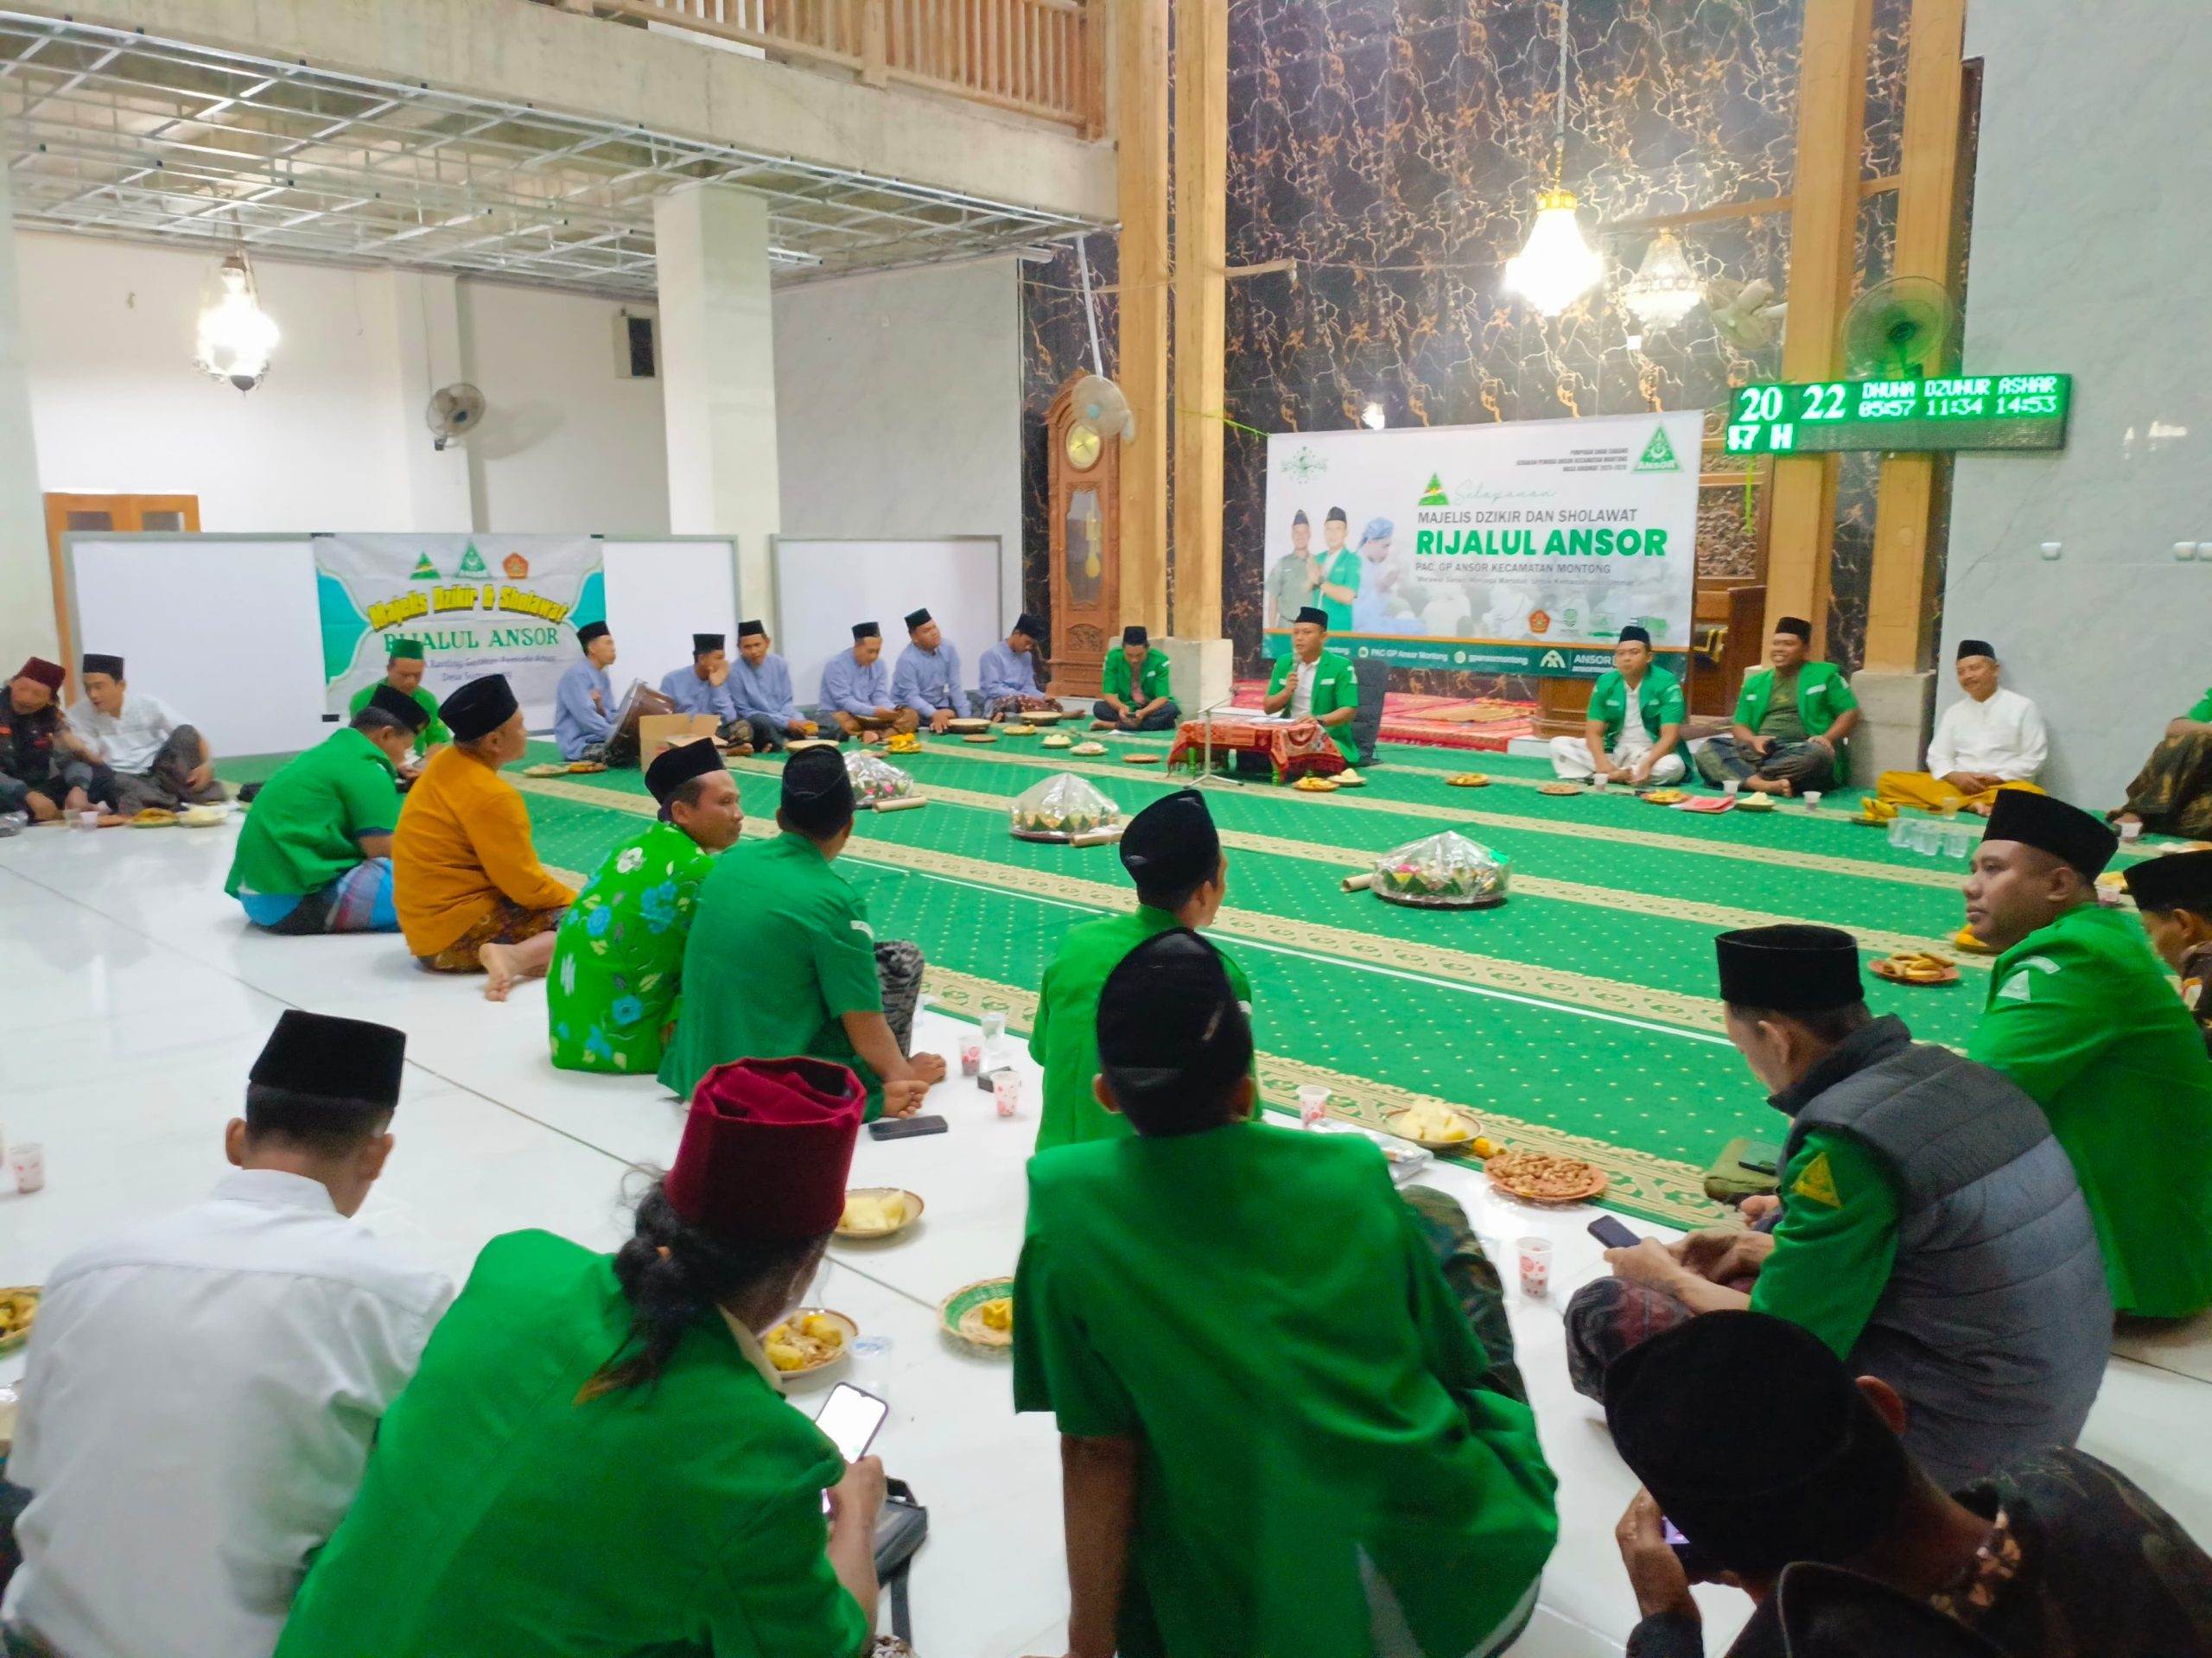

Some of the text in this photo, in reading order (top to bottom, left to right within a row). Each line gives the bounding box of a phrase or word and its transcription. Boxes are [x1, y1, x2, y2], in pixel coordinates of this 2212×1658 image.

[1862, 376, 2057, 399] DHUHA DZUHUR ASHAR
[1738, 383, 1846, 422] 20 22
[1926, 397, 1984, 416] 11:34
[1995, 396, 2057, 415] 14:53
[1770, 422, 1794, 450] H
[1637, 460, 1677, 469] ANSOR
[1418, 508, 1638, 524] MAJELIS DZIKIR DAN SHOLAWAT
[1415, 528, 1669, 556] RIJALUL ANSOR
[1439, 562, 1452, 572] GP
[1455, 562, 1488, 573] ANSOR
[1491, 563, 1553, 573] KECAMATAN
[1557, 563, 1611, 574] MONTONG
[367, 590, 429, 632] Majelis
[433, 584, 479, 614] Dzikir
[499, 585, 569, 626] Sholawat
[489, 627, 560, 648] ANSOR
[1386, 649, 1397, 657] GP
[1398, 650, 1418, 659] Ansor
[1419, 651, 1448, 662] Montong
[1573, 654, 1611, 664] ANSOR
